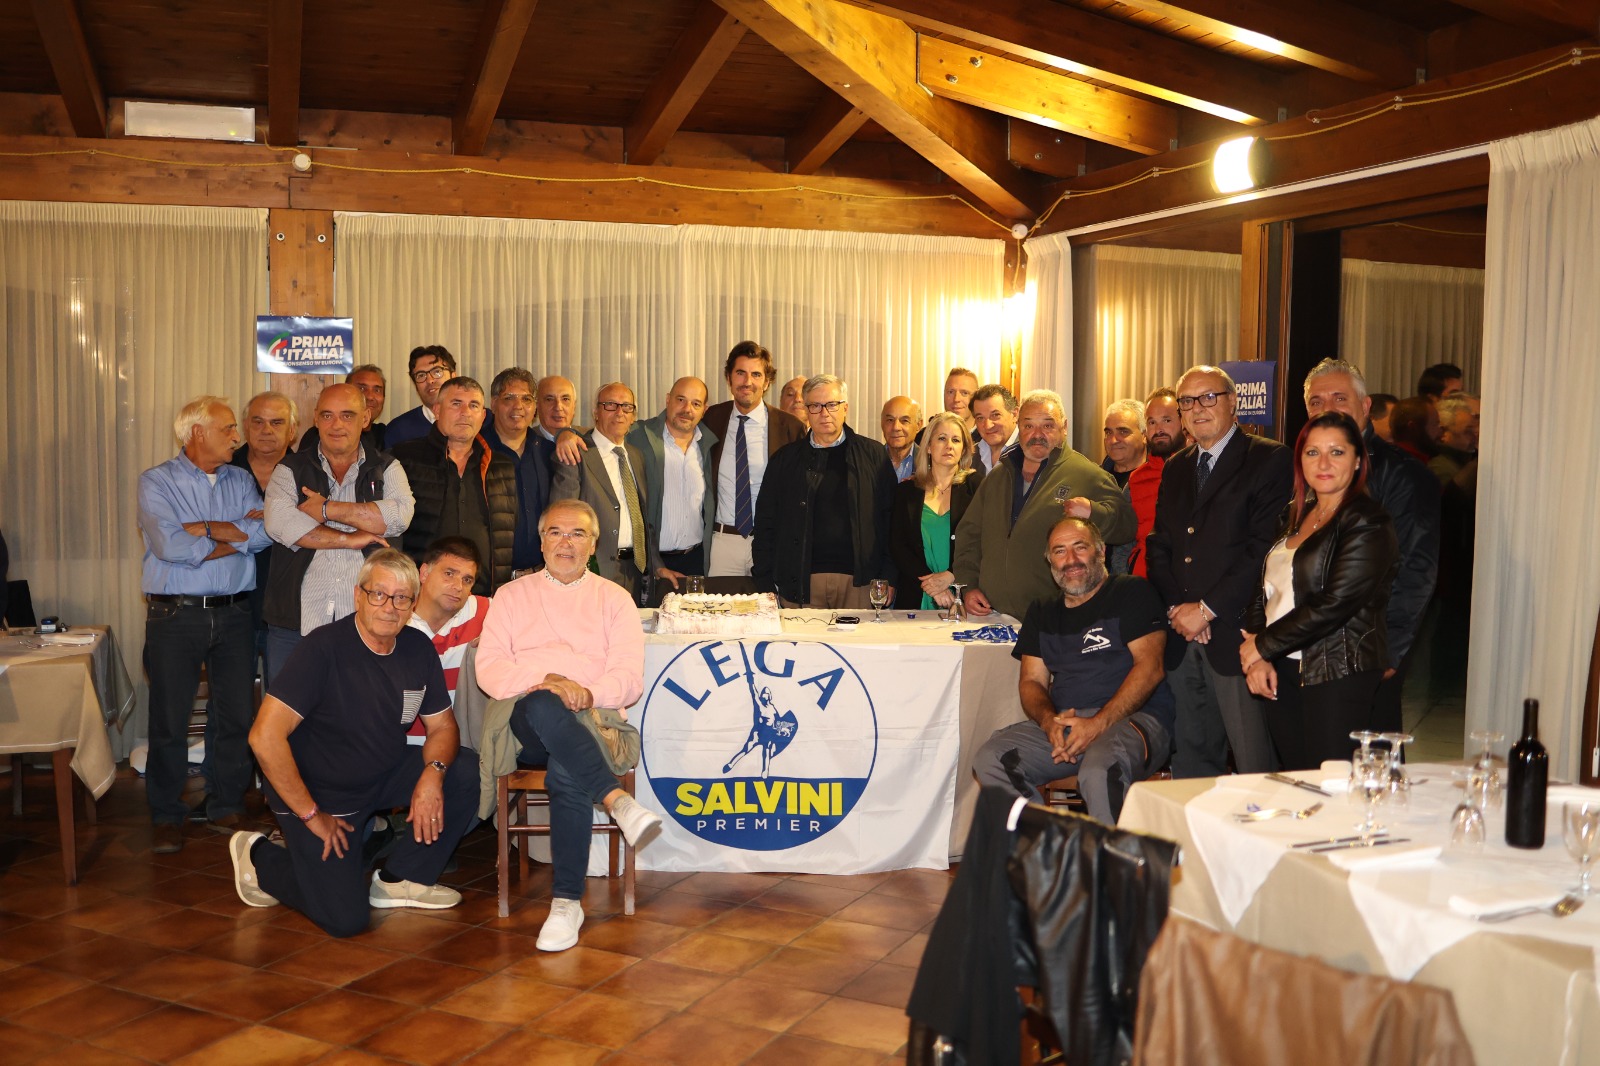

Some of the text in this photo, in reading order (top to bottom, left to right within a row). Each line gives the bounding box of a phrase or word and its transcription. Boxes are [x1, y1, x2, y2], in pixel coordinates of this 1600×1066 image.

[291, 335, 344, 348] PRIMA
[275, 348, 344, 360] L'ITALIA!
[1235, 382, 1266, 396] PRIMA
[1236, 396, 1266, 409] TALIA!
[662, 641, 845, 711] LEGA
[675, 781, 843, 816] SALVINI
[697, 818, 820, 832] PREMIER
